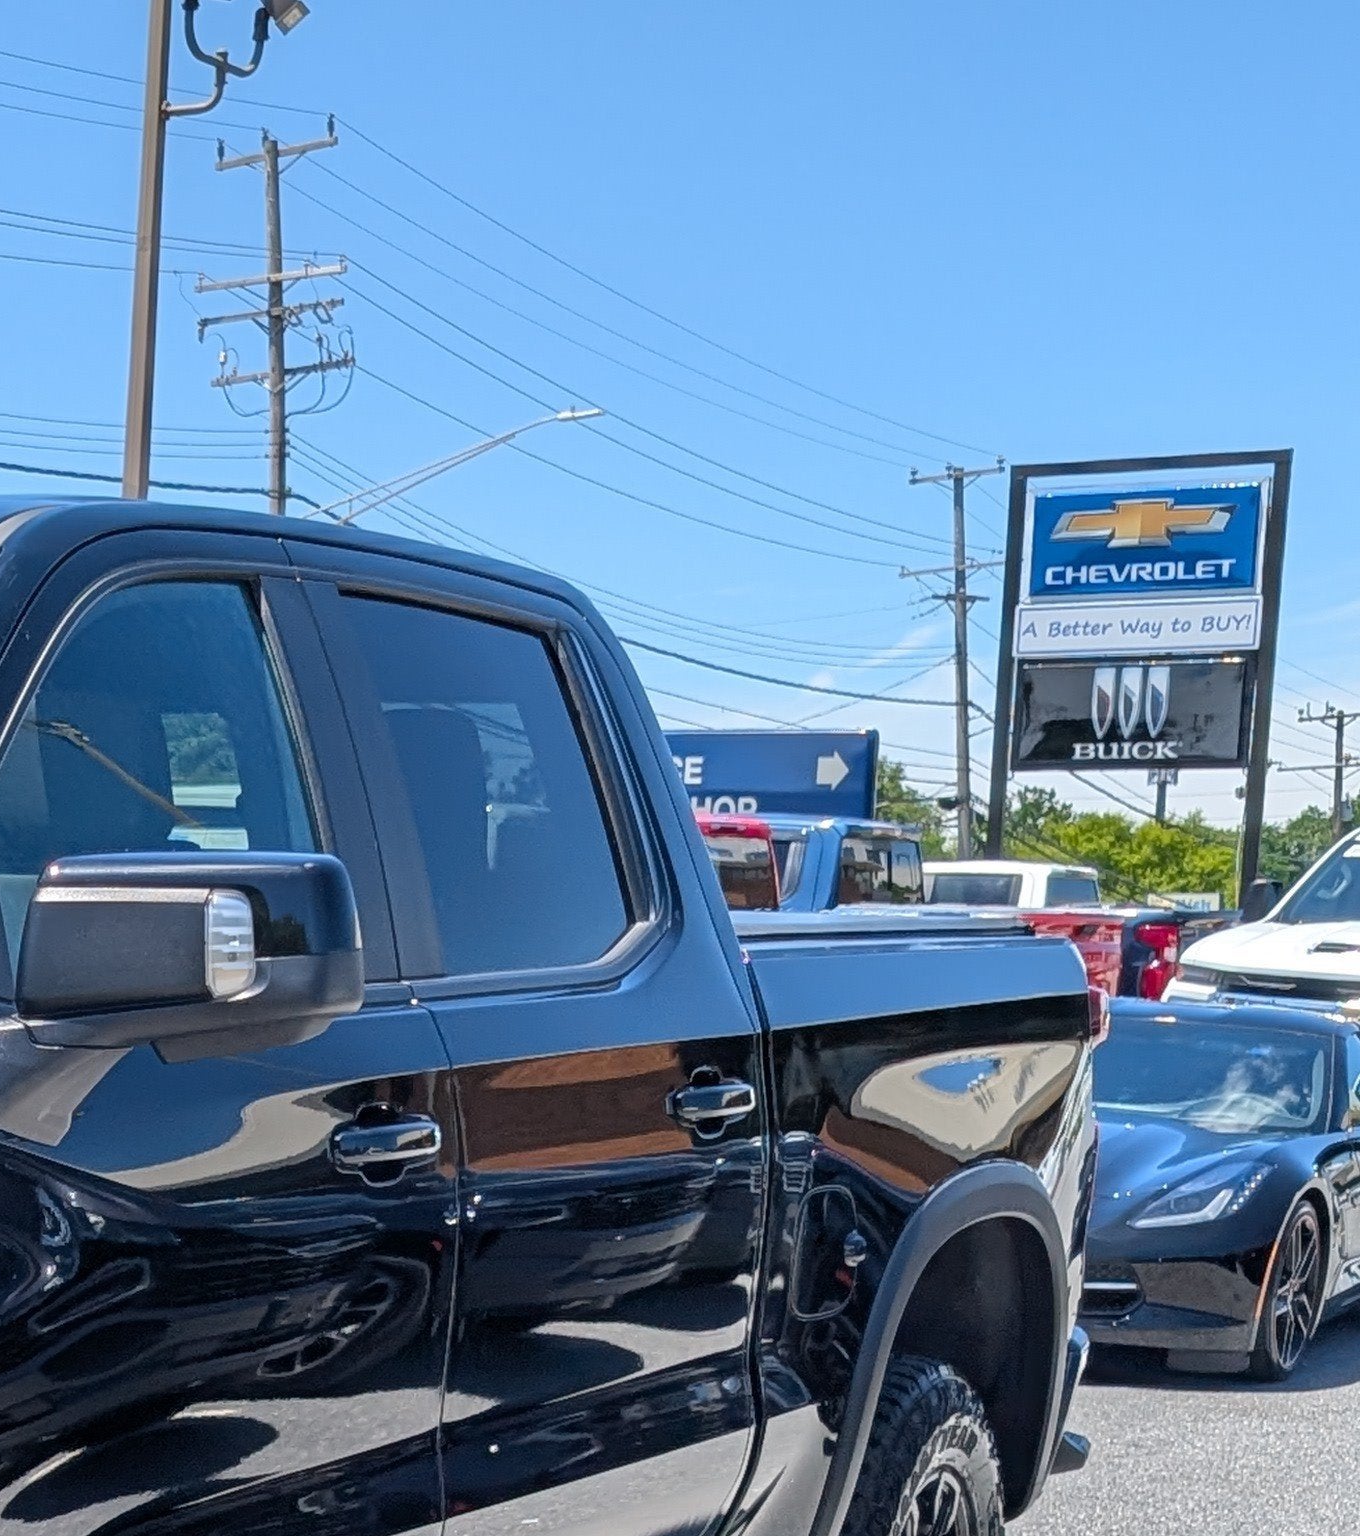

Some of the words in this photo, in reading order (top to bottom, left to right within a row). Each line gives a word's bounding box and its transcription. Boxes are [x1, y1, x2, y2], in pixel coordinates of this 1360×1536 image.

[1044, 558, 1237, 586] CHEVROLET
[1021, 623, 1038, 638] A
[1048, 620, 1113, 638] Better
[1120, 618, 1163, 639] Way
[1170, 616, 1192, 633] to
[1200, 613, 1252, 633] BUY!
[1071, 740, 1180, 760] BUICK
